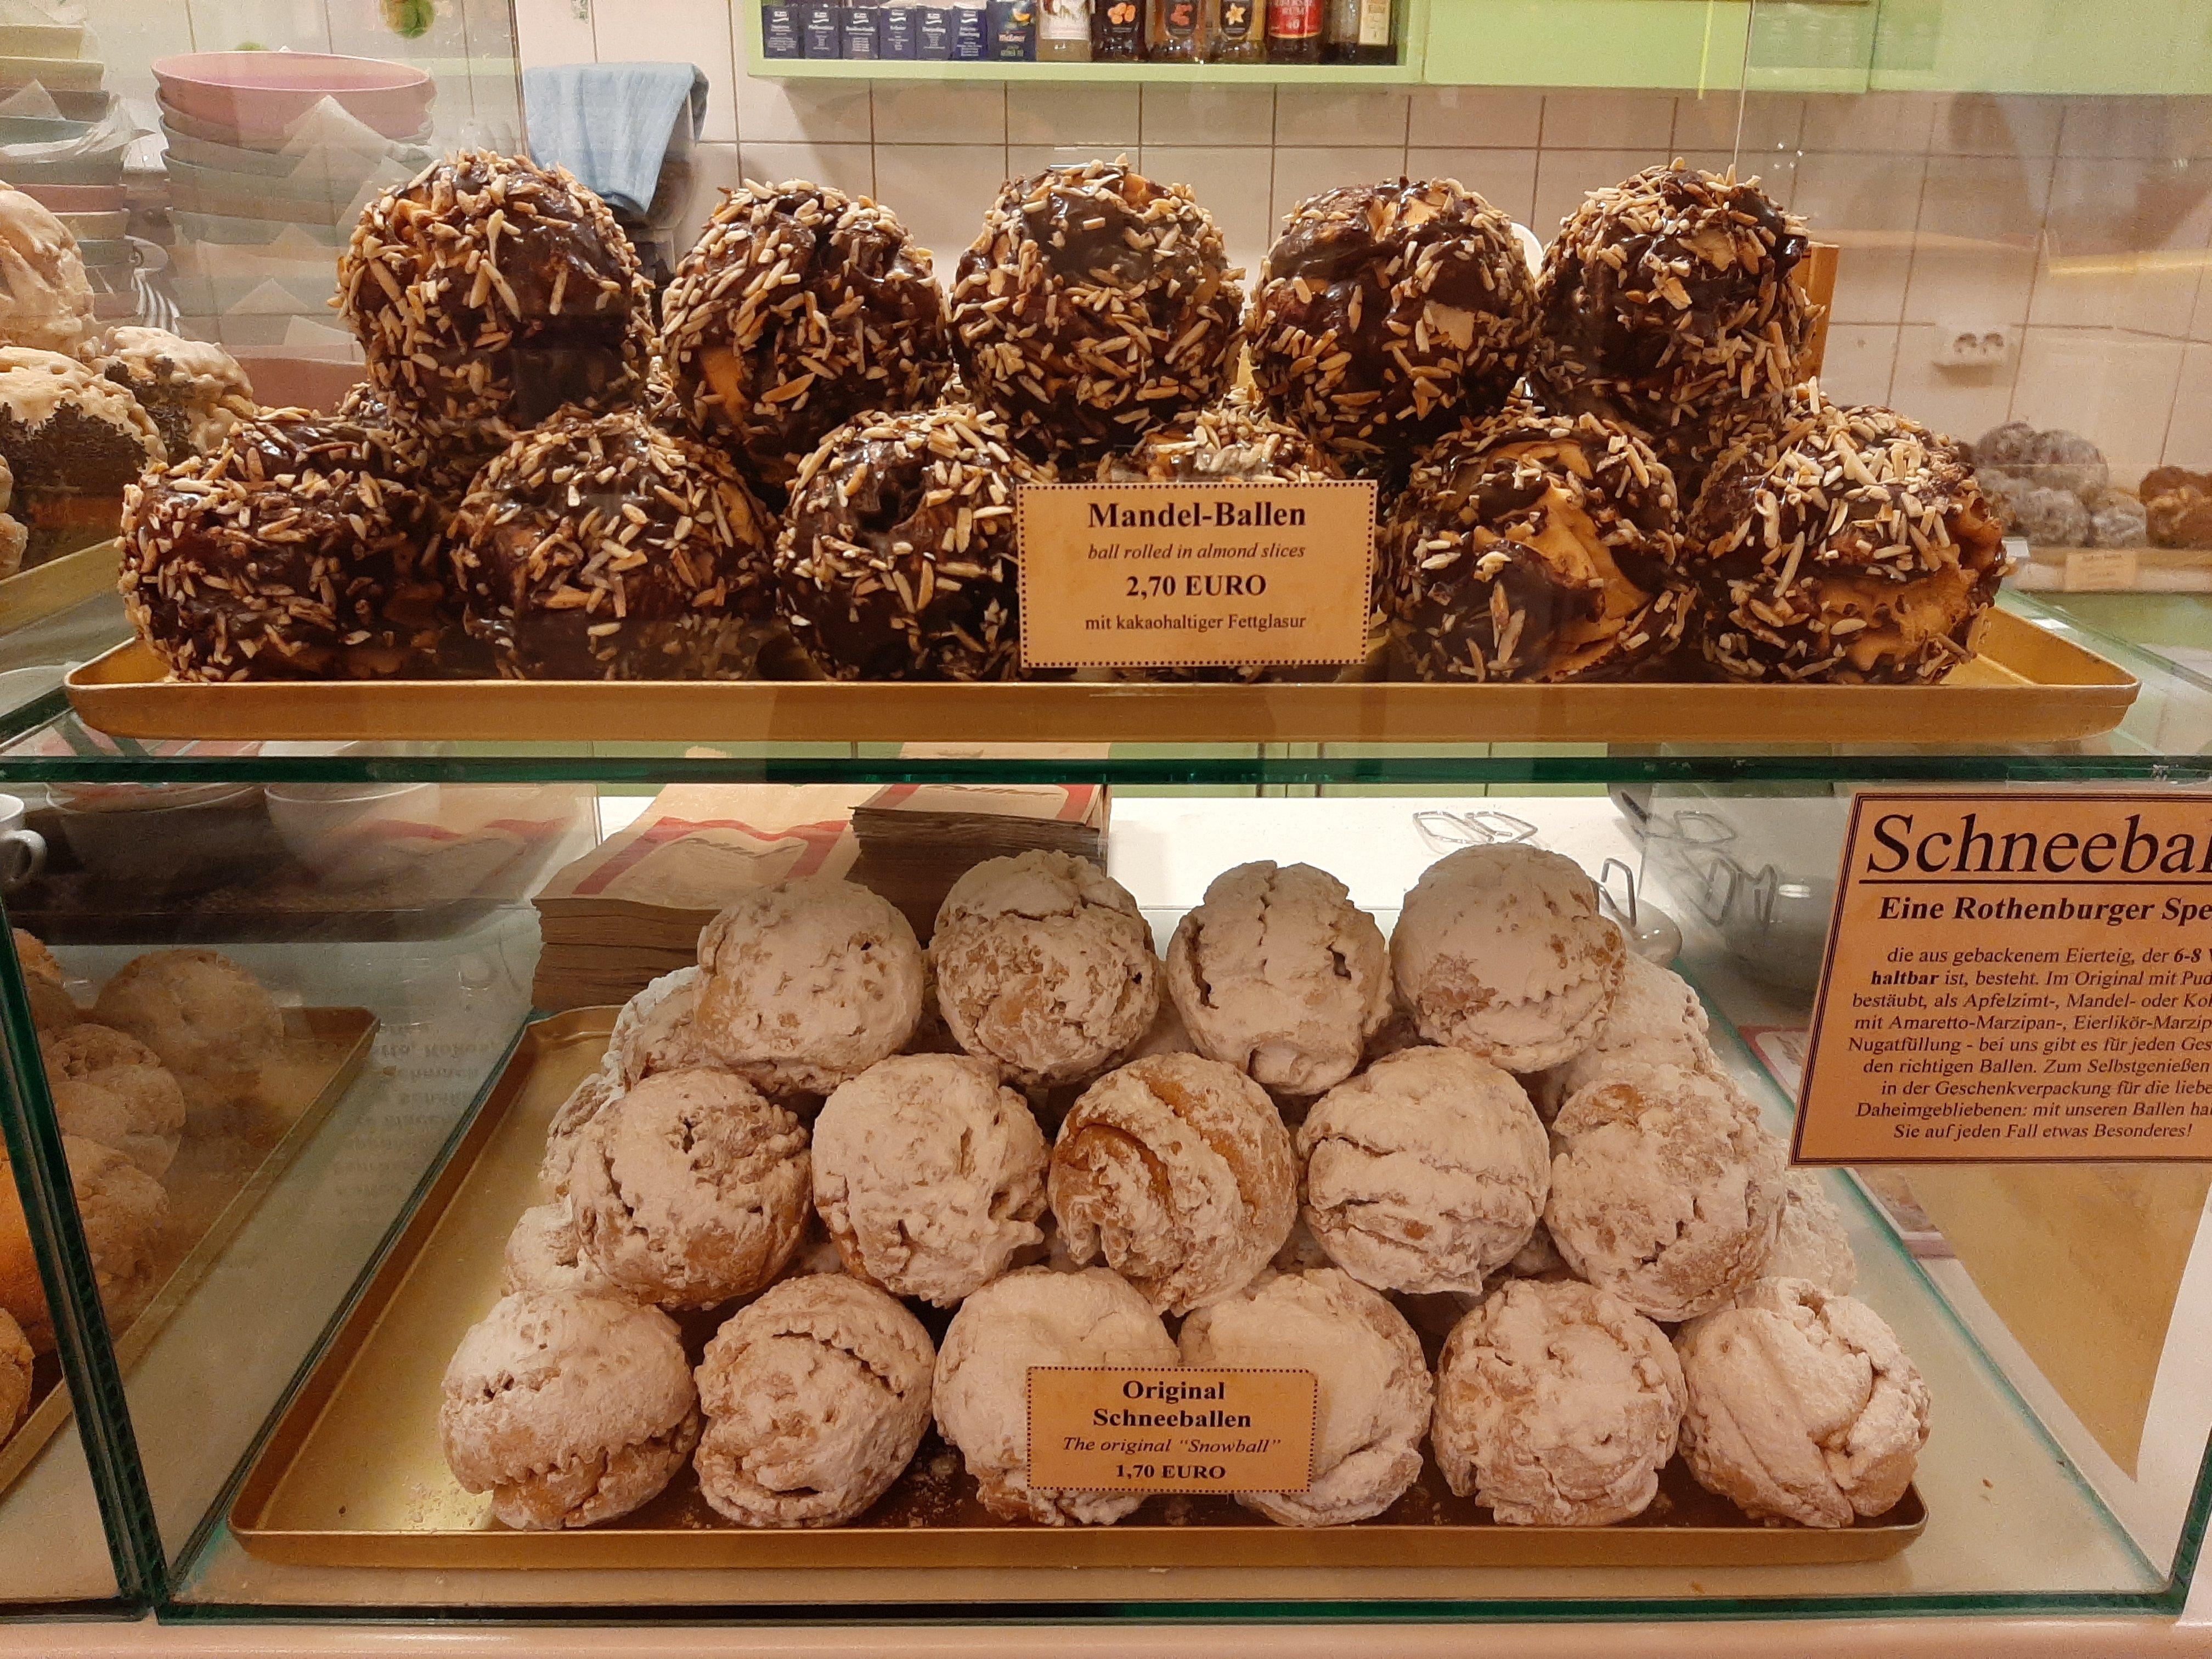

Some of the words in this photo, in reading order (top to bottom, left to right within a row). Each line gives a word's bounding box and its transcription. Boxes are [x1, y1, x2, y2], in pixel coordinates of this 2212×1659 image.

[1088, 501, 1305, 528] Mandel-Ballen
[1087, 544, 1120, 560] ball
[1124, 543, 1173, 559] rolled
[1177, 544, 1192, 559] in
[1197, 542, 1259, 558] almond
[1261, 542, 1306, 558] slices
[1126, 575, 1176, 600] 2,70
[1186, 574, 1266, 596] EURO
[1085, 614, 1112, 630] mit
[1116, 614, 1224, 633] kakaohaltiger
[1228, 613, 1306, 633] Fettglasur
[1877, 896, 1944, 919] Eine
[1951, 897, 2155, 927] Rothenburger
[2161, 897, 2212, 927] Spe
[1887, 947, 1914, 962] die
[1918, 951, 1948, 962] aus
[1952, 947, 2059, 967] gebackenem
[2066, 947, 2135, 967] Eierteig,
[2142, 947, 2170, 963] der
[2174, 947, 2202, 963] 6-8
[1871, 970, 1940, 985] haltbar
[1945, 969, 1968, 986] ist,
[1976, 970, 2039, 985] besteht.
[2045, 970, 2069, 986] Im
[2075, 970, 2145, 990] Original
[2148, 970, 2177, 986] mit
[1852, 992, 1927, 1010] bestäubt,
[1934, 992, 1958, 1008] als
[2067, 992, 2136, 1008] Mandel-
[2141, 992, 2180, 1008] oder
[2183, 992, 2212, 1008] Ko
[1854, 1015, 1882, 1029] mit
[1848, 1036, 1962, 1056] Nugatfüllung
[1979, 1036, 2005, 1052] bei
[2010, 1041, 2038, 1052] uns
[2042, 1037, 2076, 1056] gibt
[2080, 1041, 2098, 1052] es
[2103, 1036, 2128, 1052] für
[2129, 1036, 2175, 1055] jeden
[1863, 1058, 1893, 1073] den
[1899, 1058, 1973, 1077] richtigen
[1979, 1059, 2036, 1074] Ballen.
[2043, 1059, 2081, 1074] Zum
[2087, 1058, 2210, 1077] Selbstgenießen
[1882, 1080, 1897, 1095] in
[1902, 1080, 1931, 1095] der
[1935, 1080, 2112, 1099] Geschenkverpackung
[2117, 1080, 2141, 1095] für
[2145, 1080, 2170, 1094] die
[1855, 1102, 2028, 1121] Daheimgebliebenen:
[2033, 1102, 2061, 1116] mit
[2065, 1105, 2127, 1116] unseren
[2132, 1101, 2185, 1116] Ballen
[1893, 1124, 1920, 1138] Sie
[1925, 1123, 1954, 1138] auf
[1953, 1123, 2001, 1142] jeden
[2005, 1124, 2038, 1138] Fall
[2042, 1127, 2089, 1138] etwas
[2092, 1122, 2193, 1137] Besonderes!
[1122, 1380, 1224, 1405] Original
[1093, 1408, 1251, 1428] Schneeballen
[1063, 1437, 1095, 1451] The
[1101, 1438, 1172, 1455] original
[1116, 1464, 1155, 1480] 1,70
[1161, 1465, 1226, 1479] EURO
